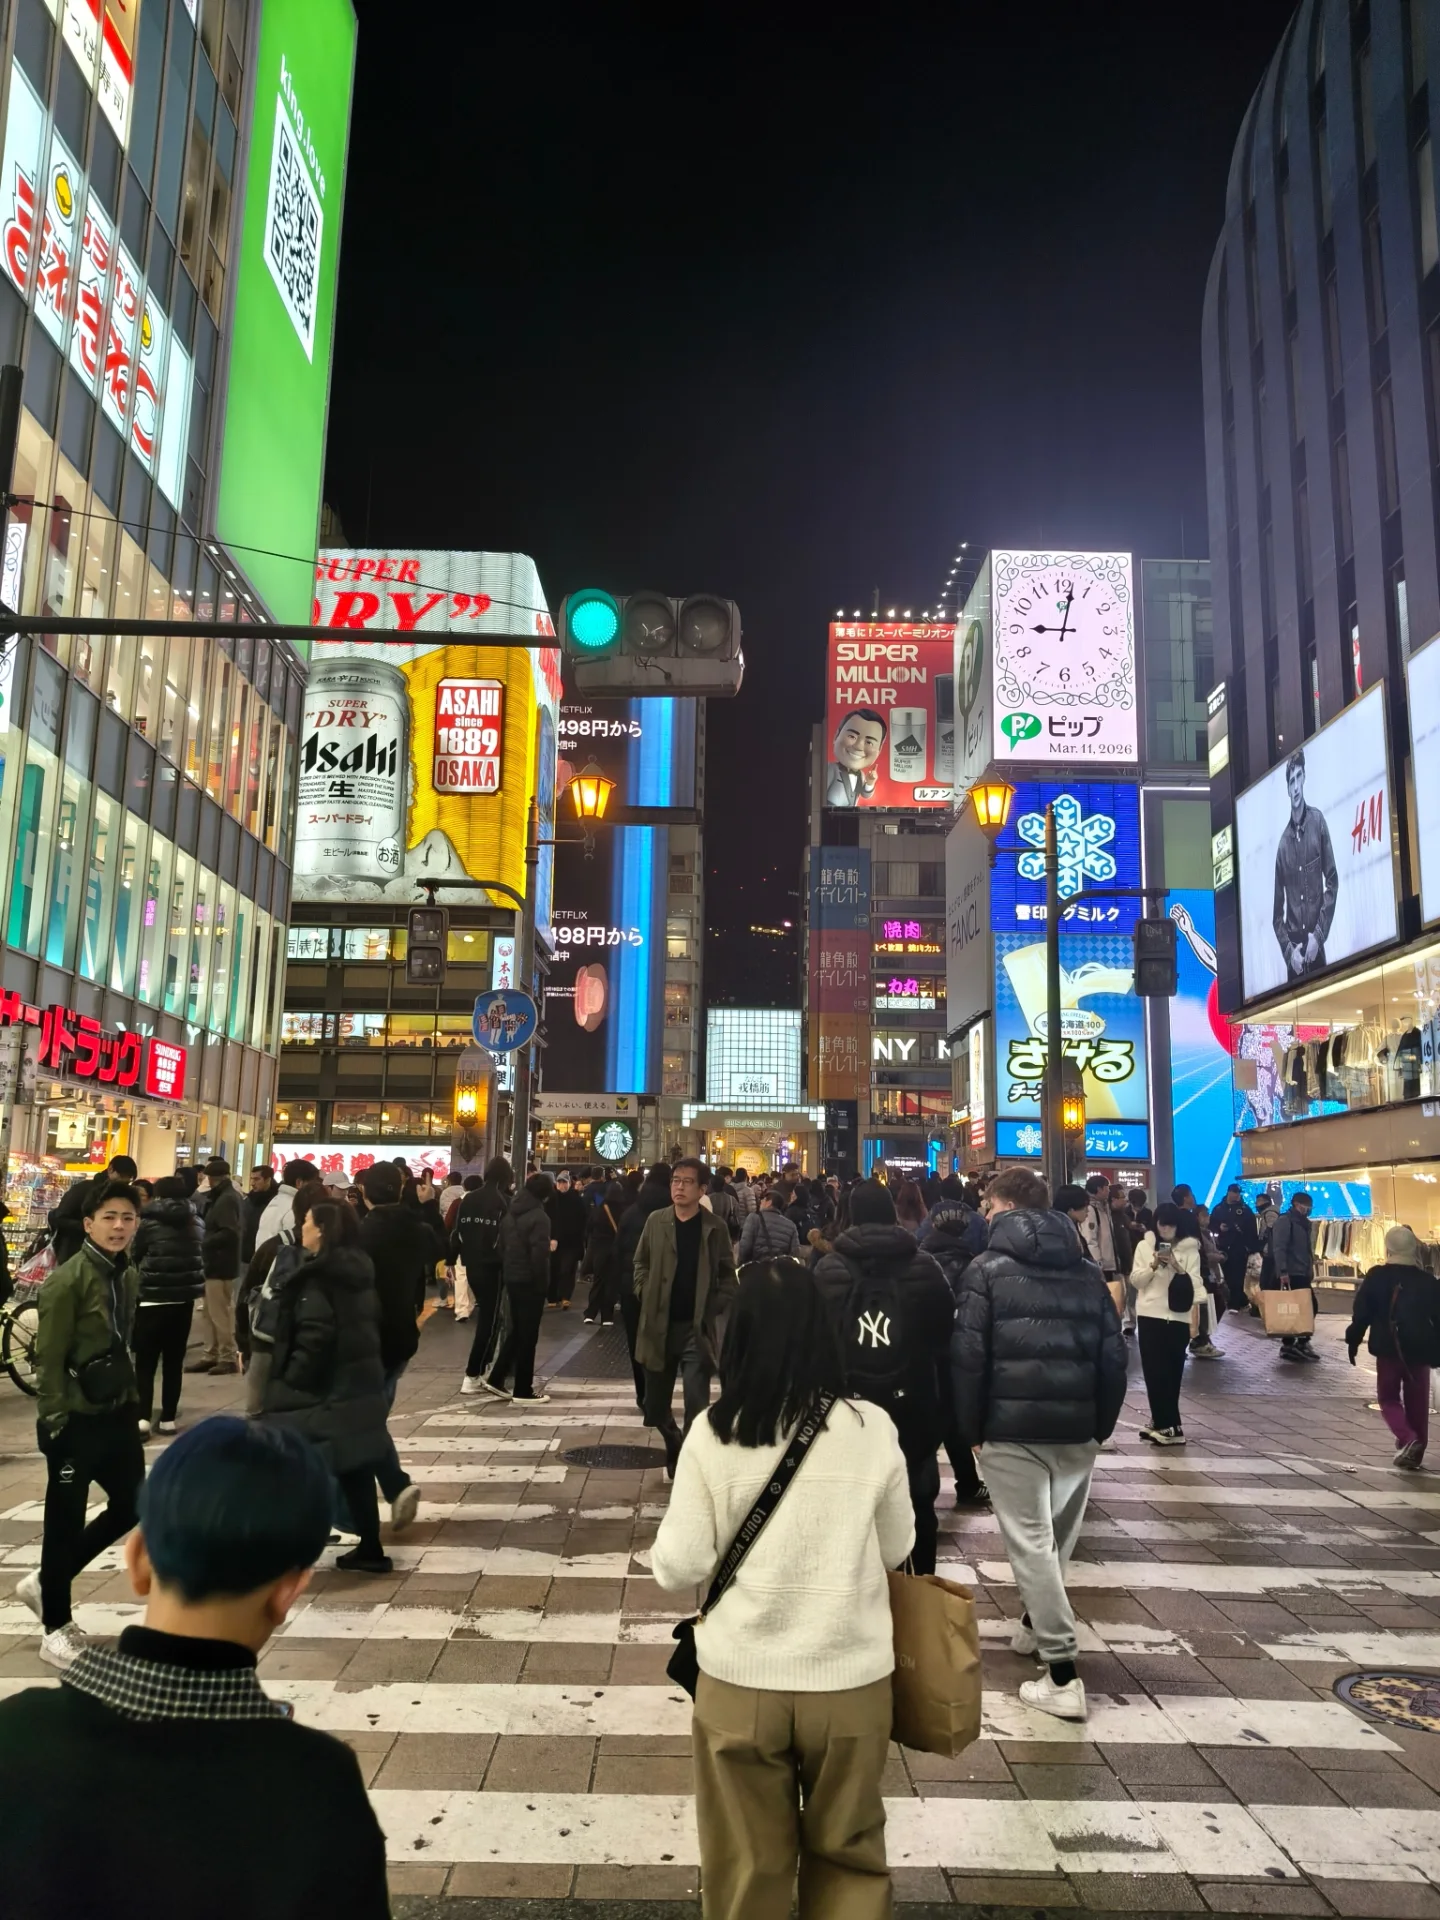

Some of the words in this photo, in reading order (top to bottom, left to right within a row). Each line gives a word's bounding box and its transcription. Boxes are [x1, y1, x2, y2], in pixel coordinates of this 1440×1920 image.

[280, 53, 326, 199] king.love
[1032, 583, 1049, 599] 11
[1082, 586, 1091, 599] 1
[1014, 597, 1032, 616] 10
[1096, 602, 1111, 615] 2
[312, 591, 491, 646] RY”
[1102, 626, 1118, 636] 3
[836, 643, 919, 662] SUPER
[1016, 646, 1031, 658] 8
[1098, 647, 1113, 660] 4
[836, 666, 927, 684] MILLION
[1036, 661, 1051, 675] 7
[1059, 667, 1071, 683] 6
[1082, 661, 1095, 676] 5
[328, 699, 368, 709] SUPER
[439, 688, 499, 716] ASAHI
[836, 687, 898, 705] HAIR
[455, 716, 483, 727] since
[1048, 715, 1104, 737] ピップ
[438, 727, 498, 755] 1889
[1049, 742, 1078, 754] Mar.
[1081, 743, 1096, 755] 11,
[1099, 743, 1133, 755] 2026
[300, 731, 397, 777] Asahi
[437, 759, 496, 787] OSAKA
[328, 780, 355, 798] 生
[918, 789, 952, 799] ルアン
[308, 813, 373, 825] スーパードライ
[1351, 789, 1383, 856] H&M
[820, 868, 859, 885] 龍角散
[1015, 903, 1120, 921] 雪印グミルク
[951, 899, 981, 959] FANCL
[820, 951, 858, 969] 龍角散
[819, 1035, 858, 1053] 龍角散
[873, 1037, 917, 1061] NY
[738, 1082, 770, 1094] 戎橋筋
[857, 1310, 891, 1348] NY
[741, 1507, 767, 1541] LOUIS
